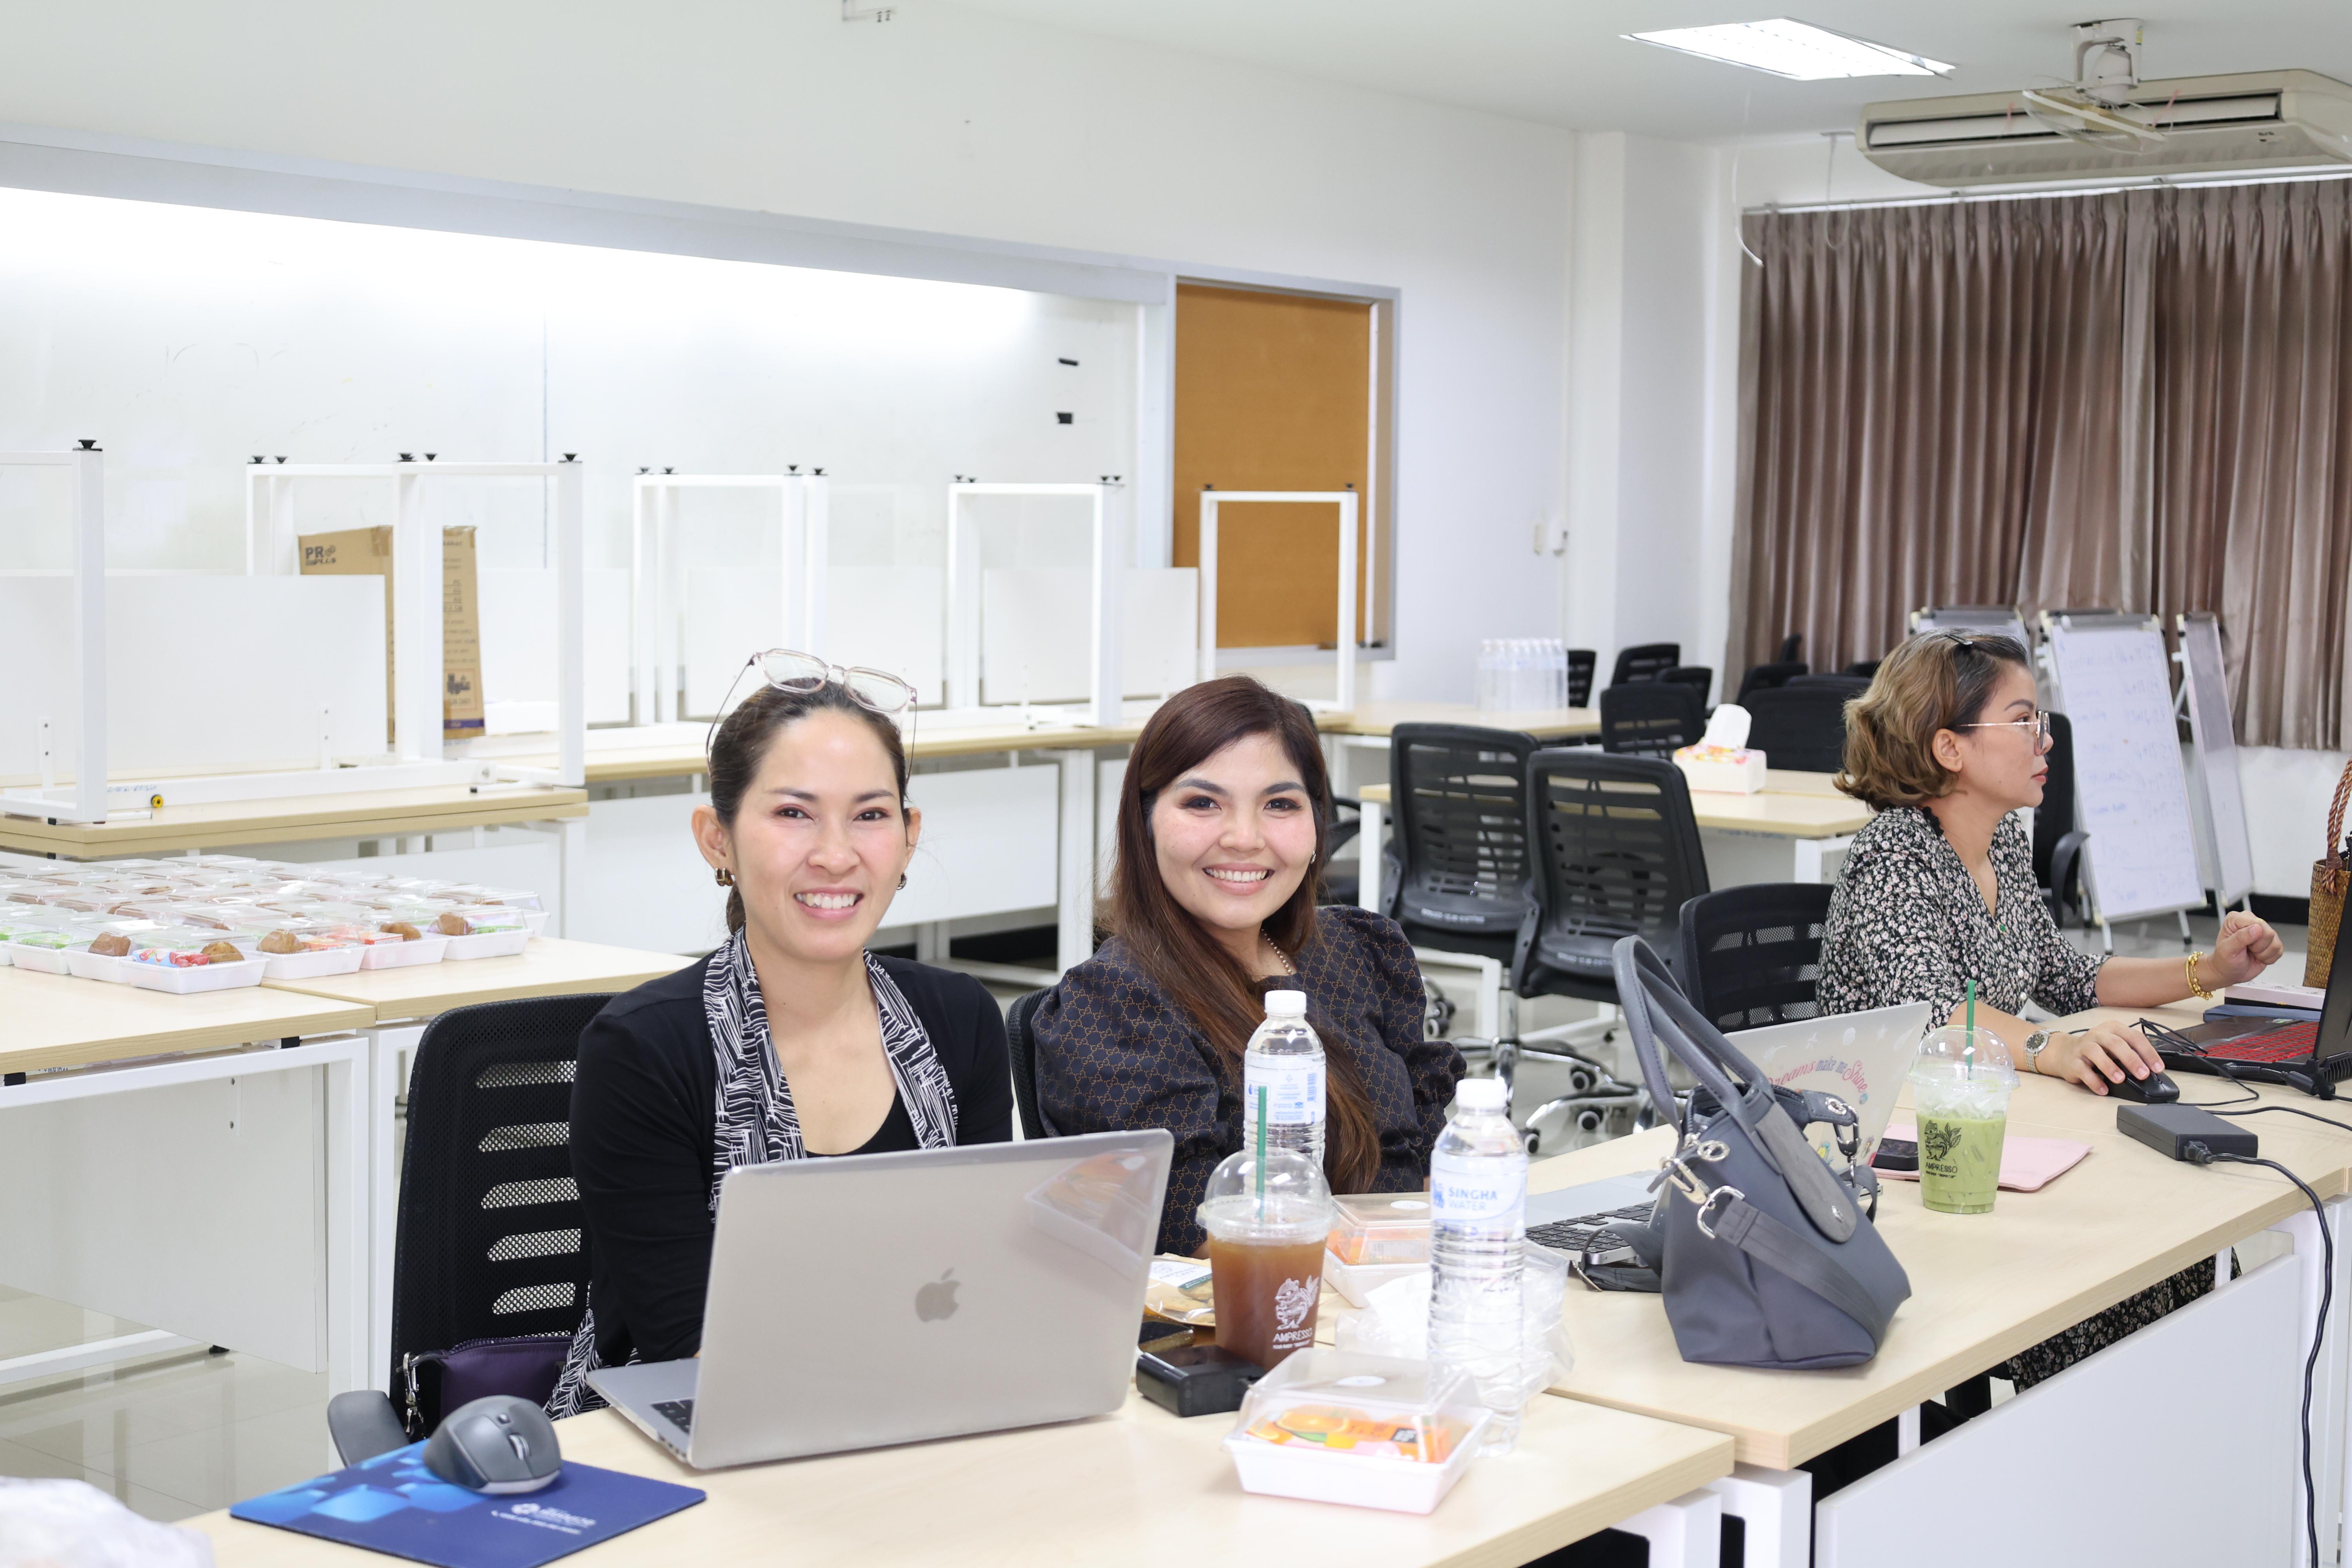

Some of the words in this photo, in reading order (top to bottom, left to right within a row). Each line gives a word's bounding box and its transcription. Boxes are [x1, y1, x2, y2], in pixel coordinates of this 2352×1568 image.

[1815, 1056, 1837, 1071] make
[1835, 1061, 1847, 1074] me
[1842, 1060, 1868, 1093] Shine
[1926, 1162, 1958, 1173] AMPRESSO
[1448, 1187, 1498, 1200] SINGHA
[1449, 1200, 1487, 1210] WATER
[1273, 1327, 1313, 1342] AMPRESSO
